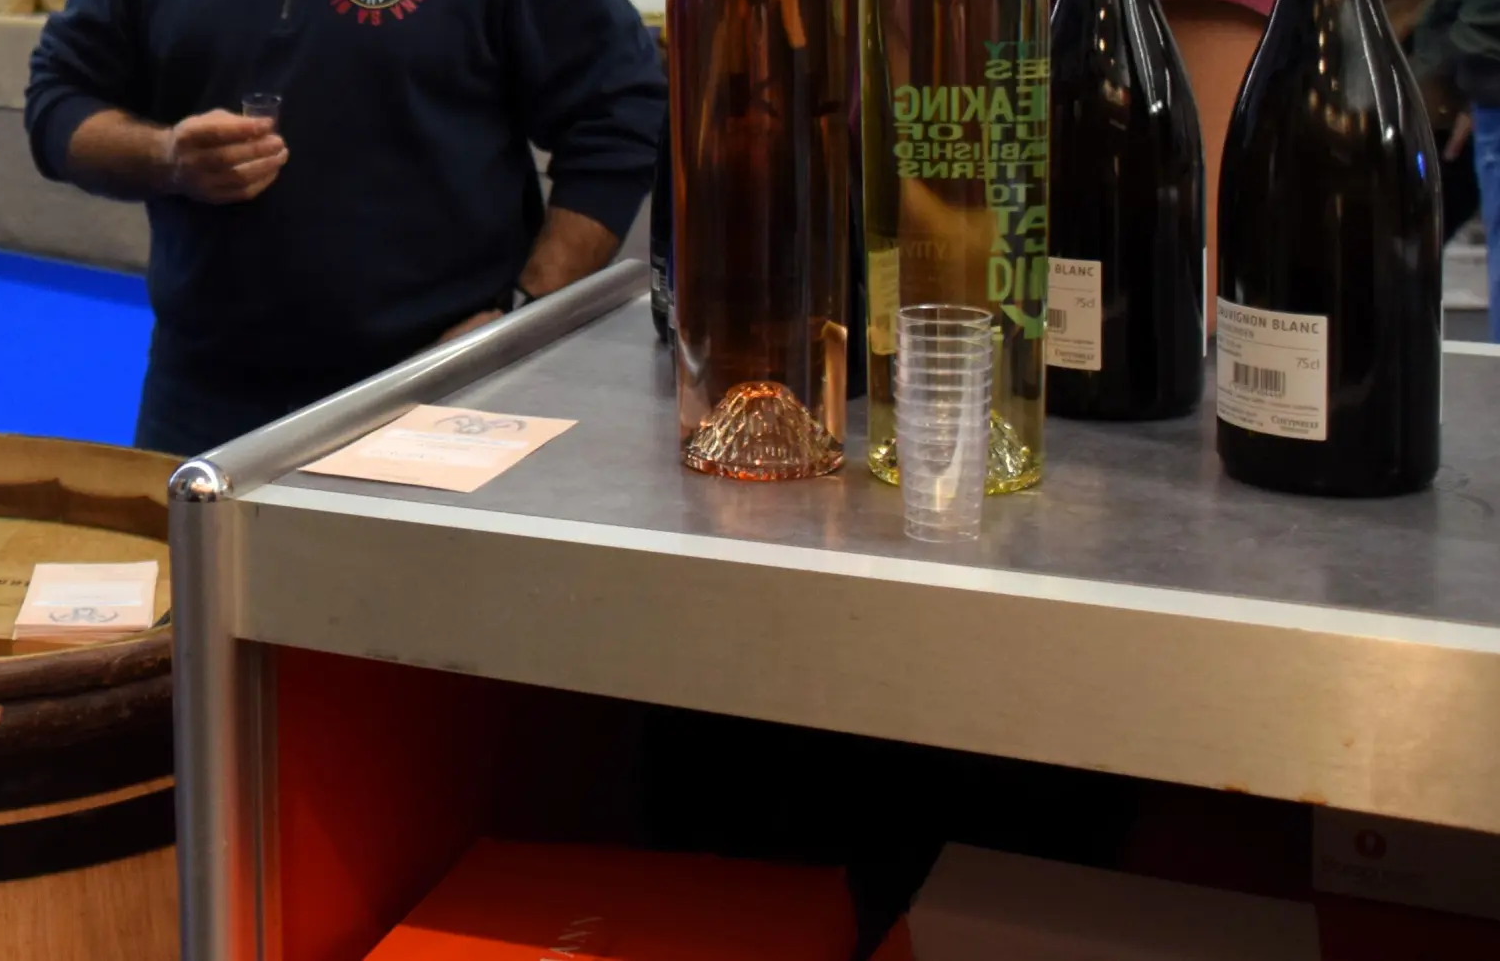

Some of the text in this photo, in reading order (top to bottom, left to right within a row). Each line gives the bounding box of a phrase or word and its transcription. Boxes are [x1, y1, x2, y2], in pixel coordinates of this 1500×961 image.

[1054, 263, 1095, 277] BLANC
[1073, 296, 1096, 309] 75cl
[1271, 318, 1320, 335] BLANC
[1295, 356, 1321, 371] 75cl
